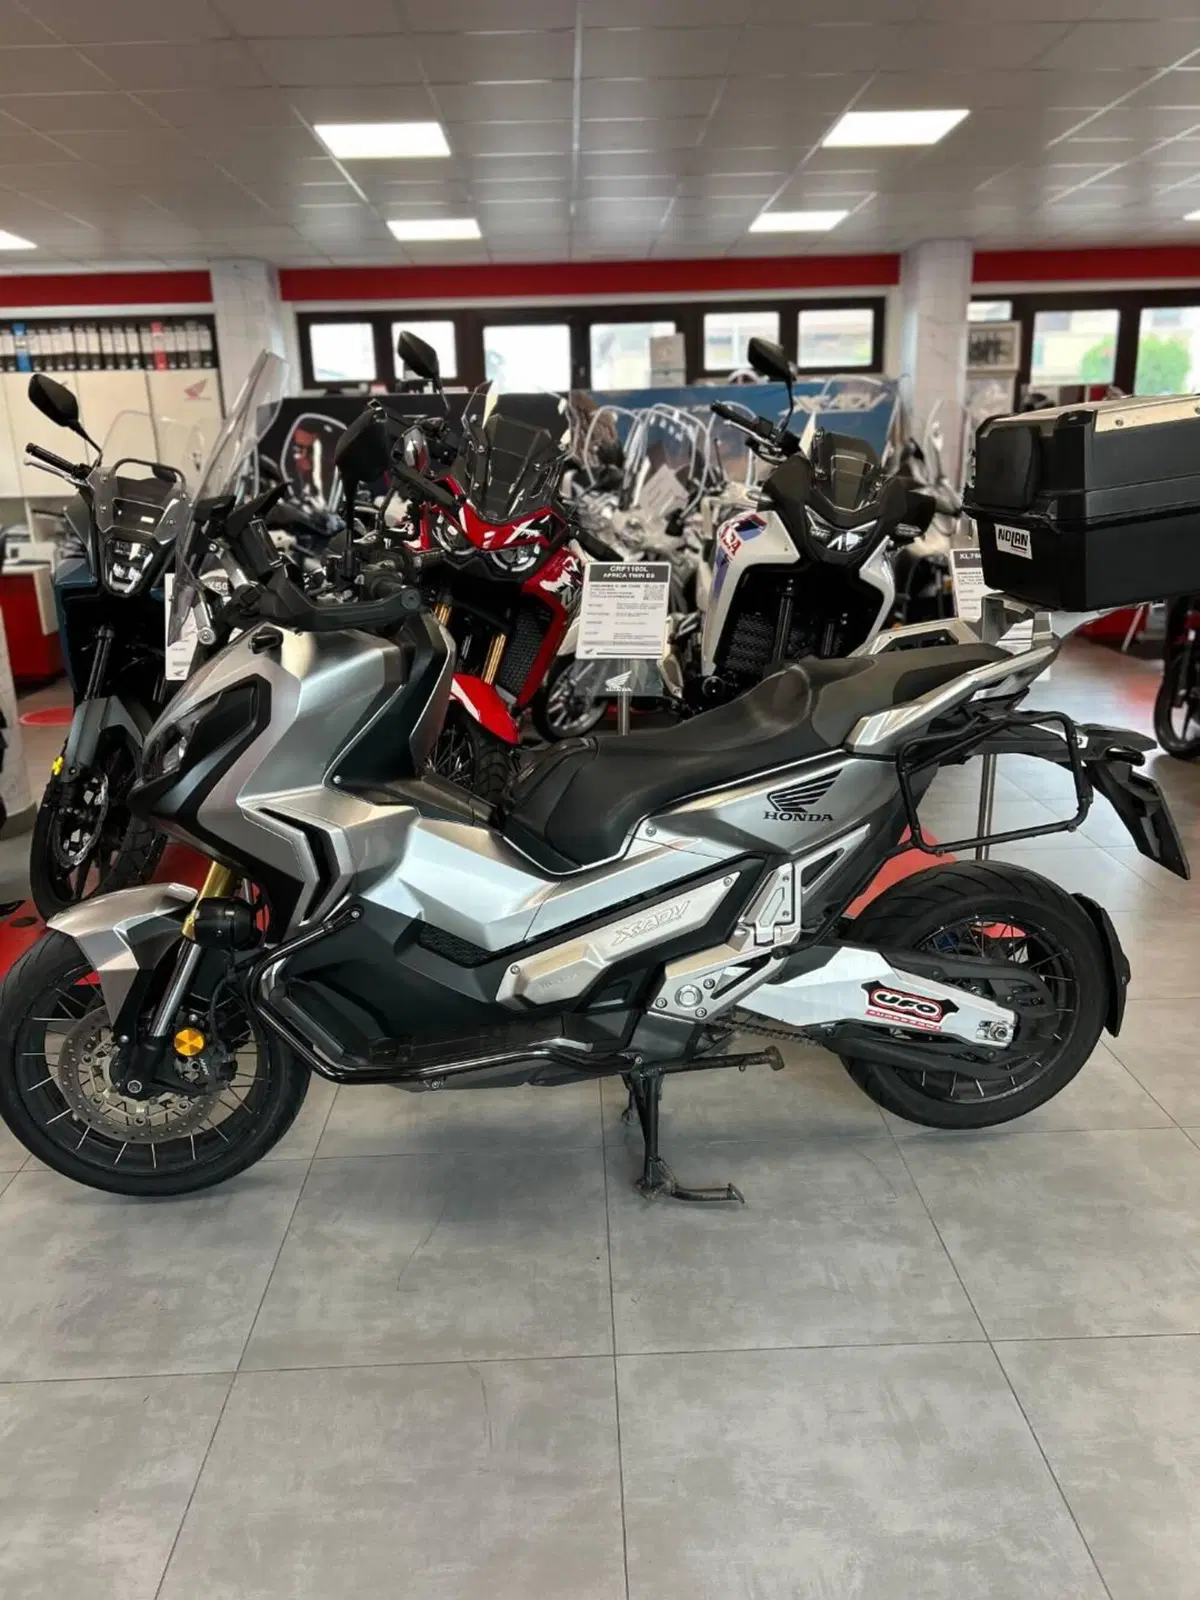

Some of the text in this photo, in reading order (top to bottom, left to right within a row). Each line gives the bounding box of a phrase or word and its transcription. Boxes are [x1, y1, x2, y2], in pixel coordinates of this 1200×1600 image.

[998, 528, 1029, 551] NOLAN
[763, 811, 834, 822] HONDA
[874, 989, 939, 1014] UFO
